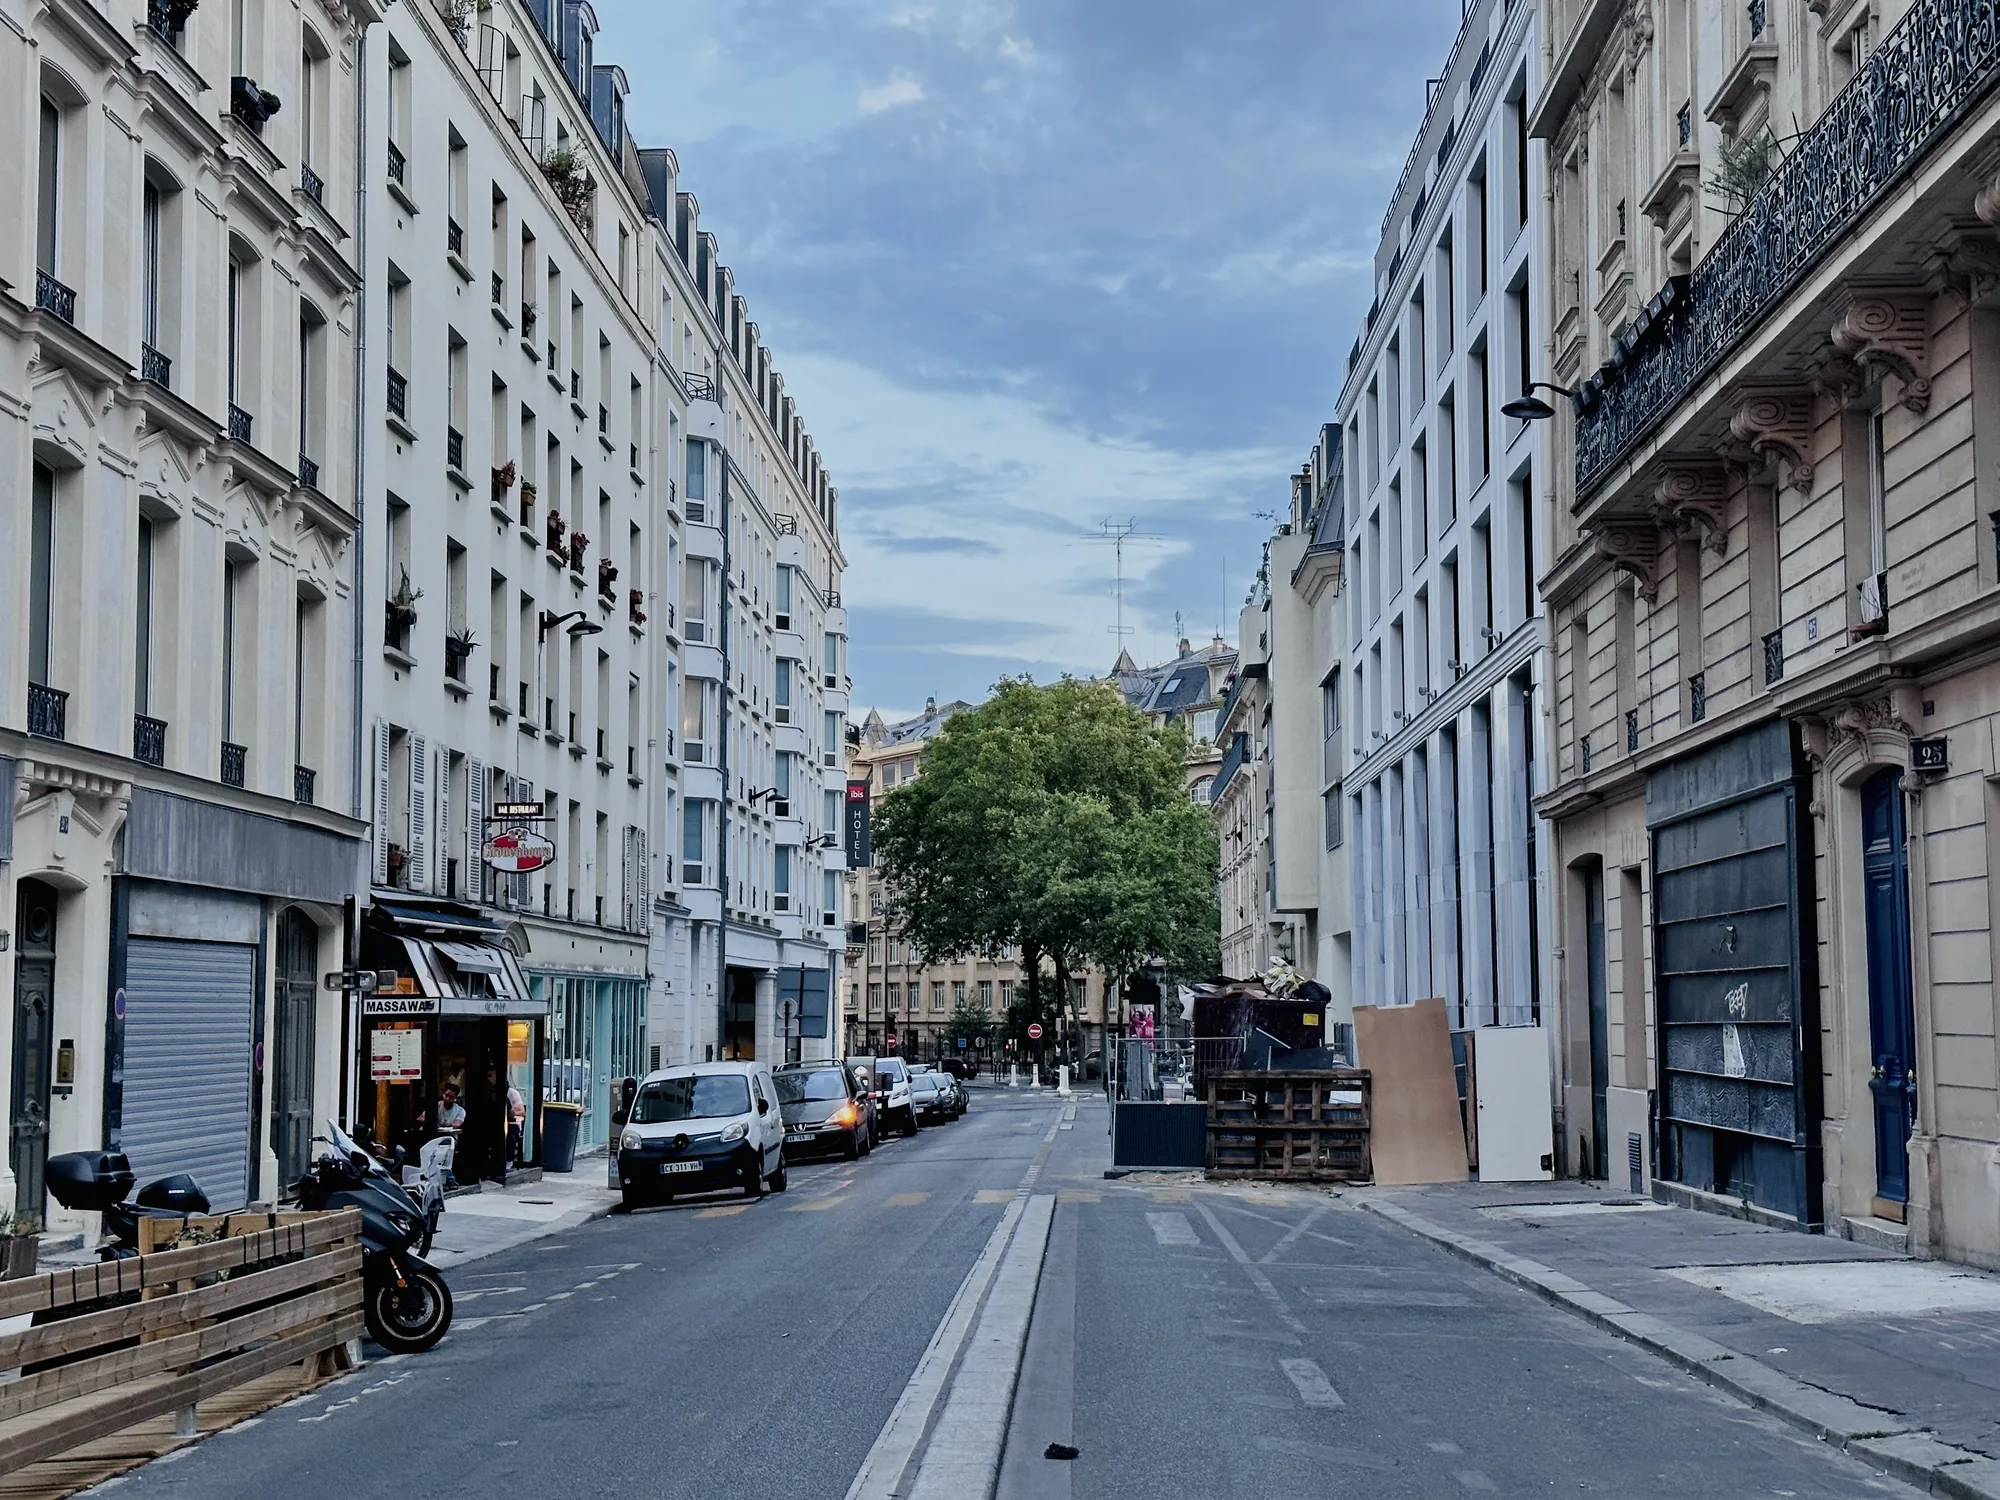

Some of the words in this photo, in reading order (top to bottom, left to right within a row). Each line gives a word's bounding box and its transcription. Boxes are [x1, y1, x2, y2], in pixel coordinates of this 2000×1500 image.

[1922, 746, 1942, 764] 25
[850, 790, 864, 799] ibis
[853, 809, 862, 860] HOTEL
[484, 842, 552, 860] Kronenbourg
[366, 1001, 427, 1013] MASSAWA
